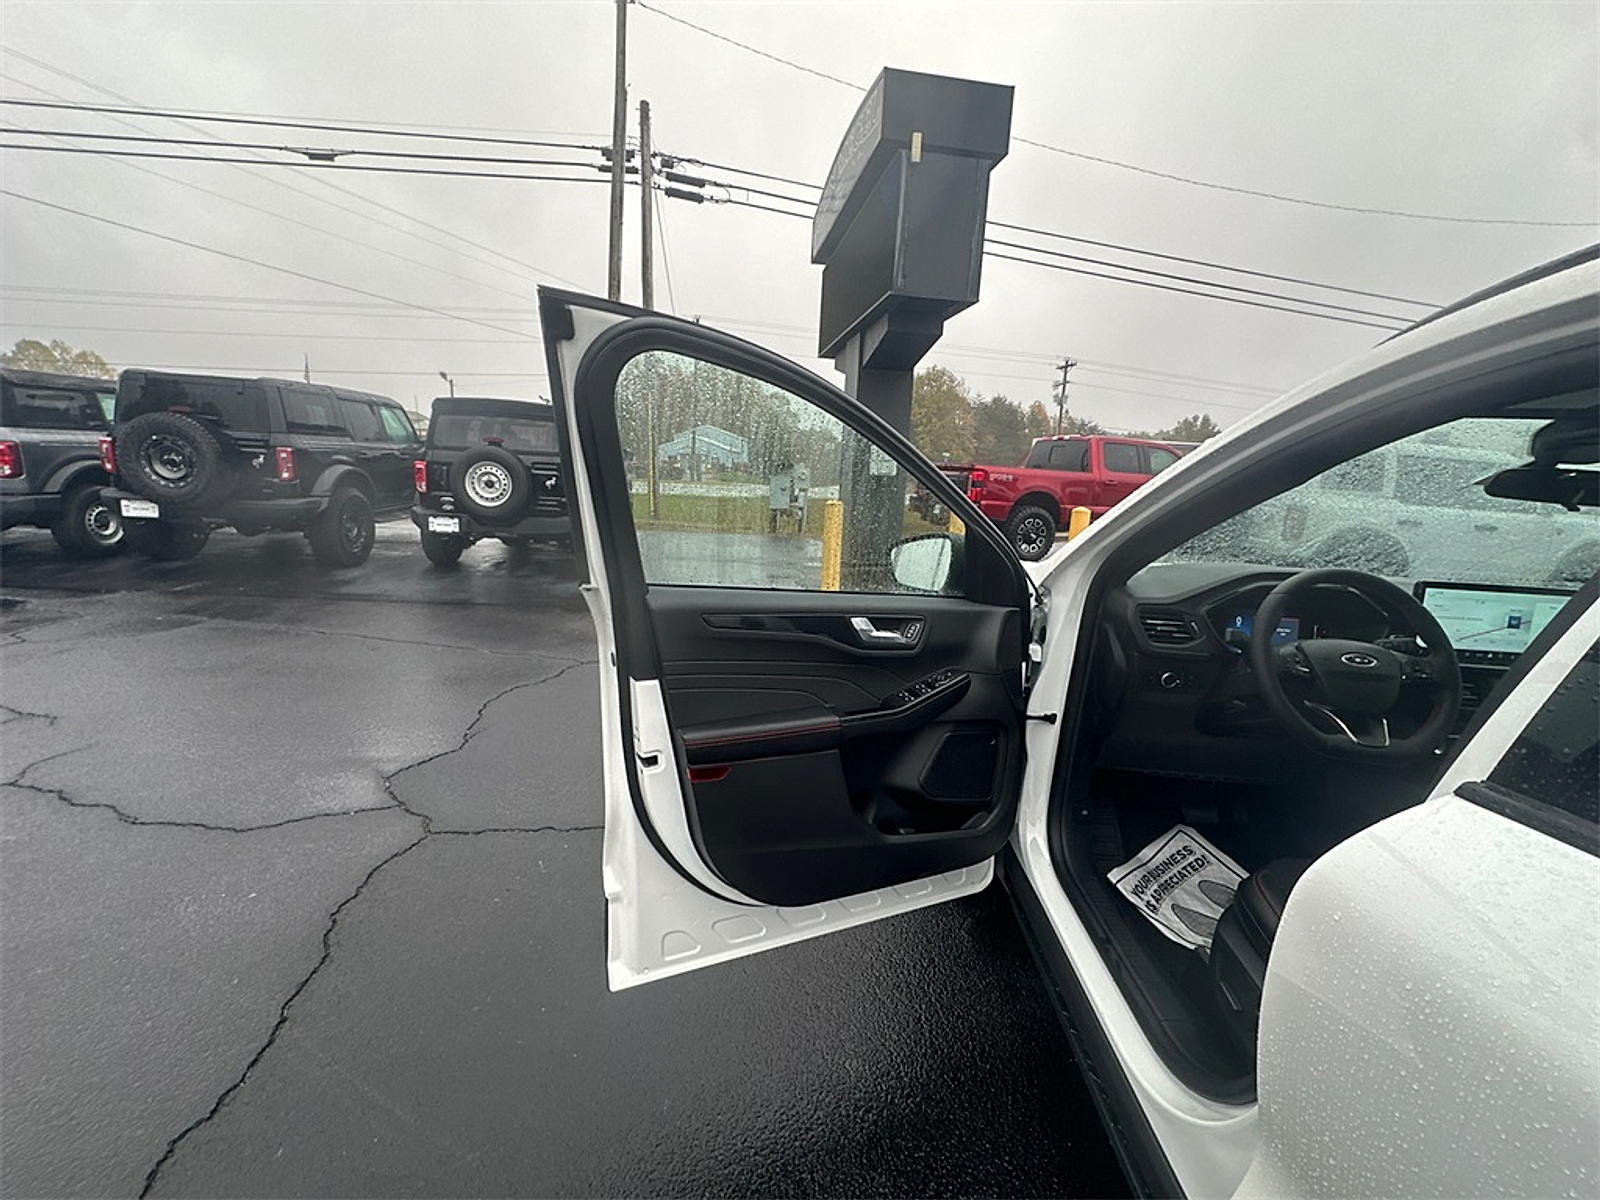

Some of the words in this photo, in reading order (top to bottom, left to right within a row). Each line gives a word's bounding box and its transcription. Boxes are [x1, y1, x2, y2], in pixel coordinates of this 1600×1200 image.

[1131, 874, 1152, 900] YOUR
[1149, 845, 1194, 880] BUSINESS
[1150, 854, 1210, 904] APPRECIATED!
[1145, 899, 1157, 914] IS
